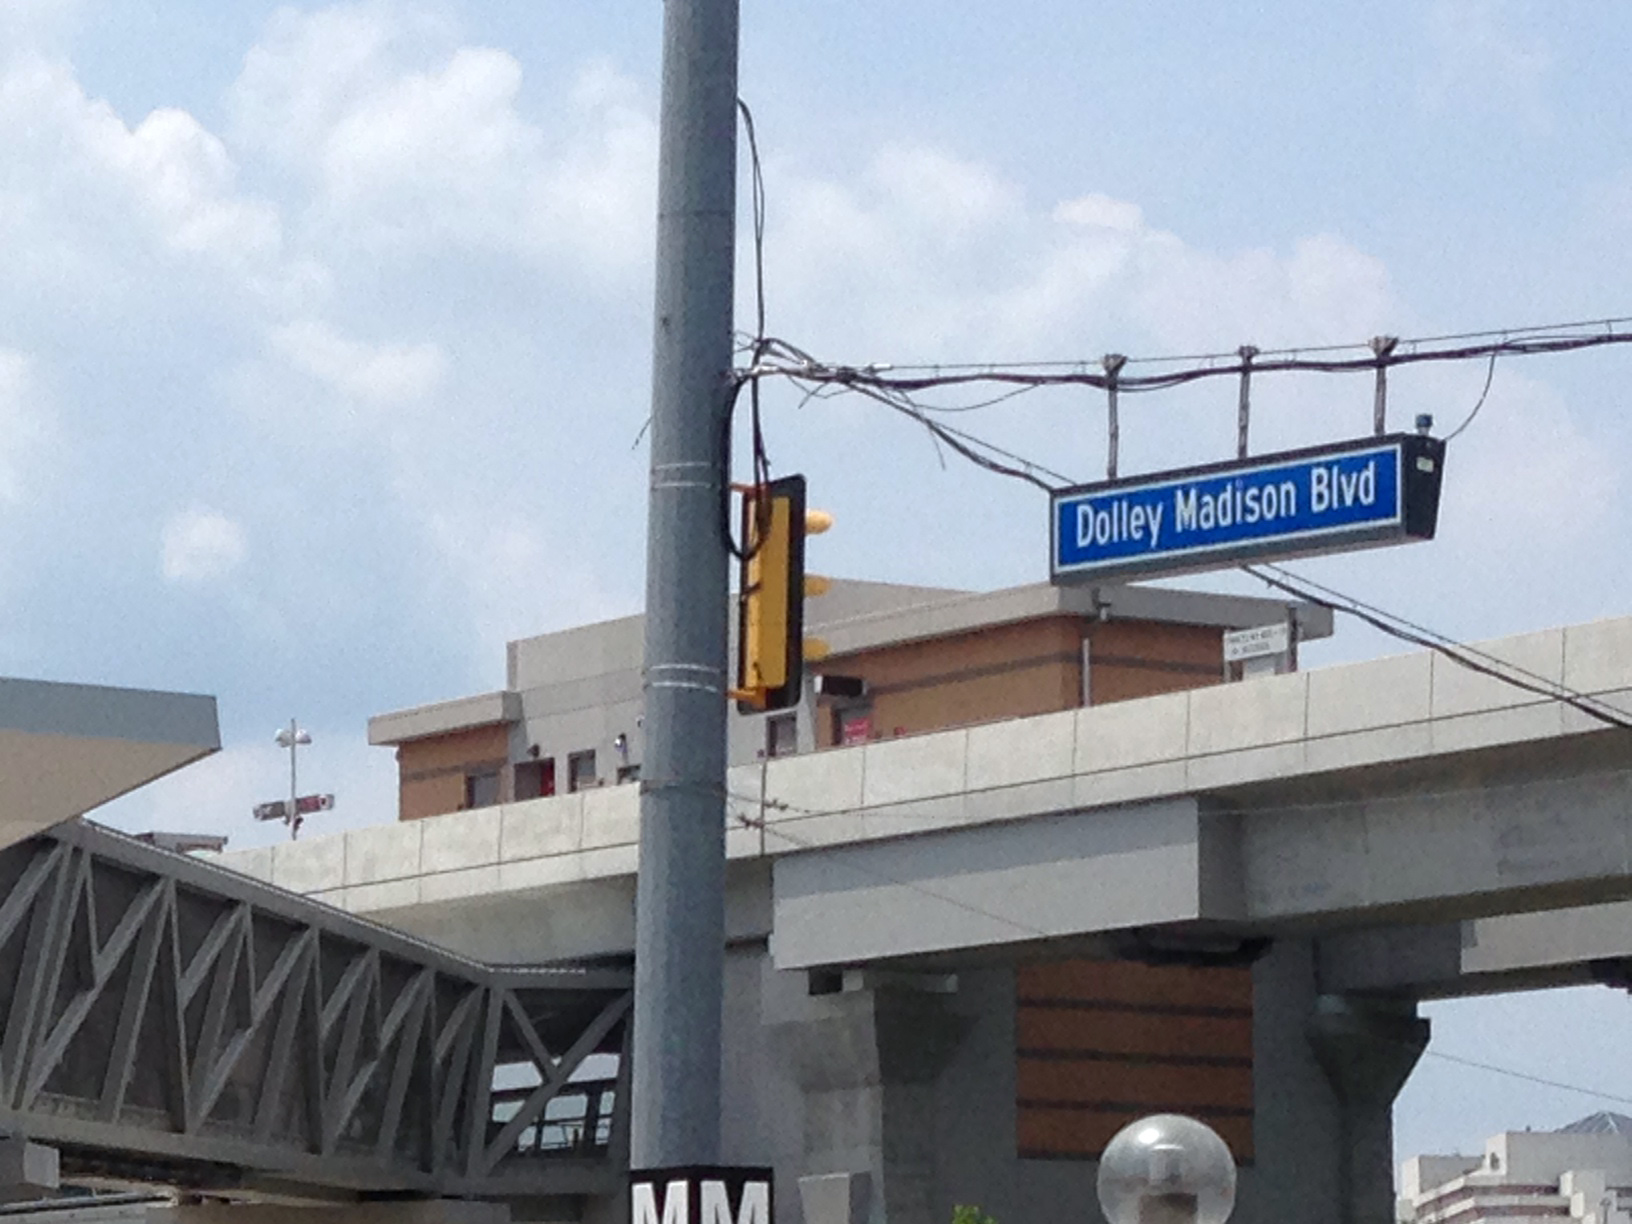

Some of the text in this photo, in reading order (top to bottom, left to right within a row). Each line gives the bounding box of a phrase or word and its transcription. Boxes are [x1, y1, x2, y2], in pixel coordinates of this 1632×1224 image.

[1076, 460, 1377, 549] Dolley Madison Blvd
